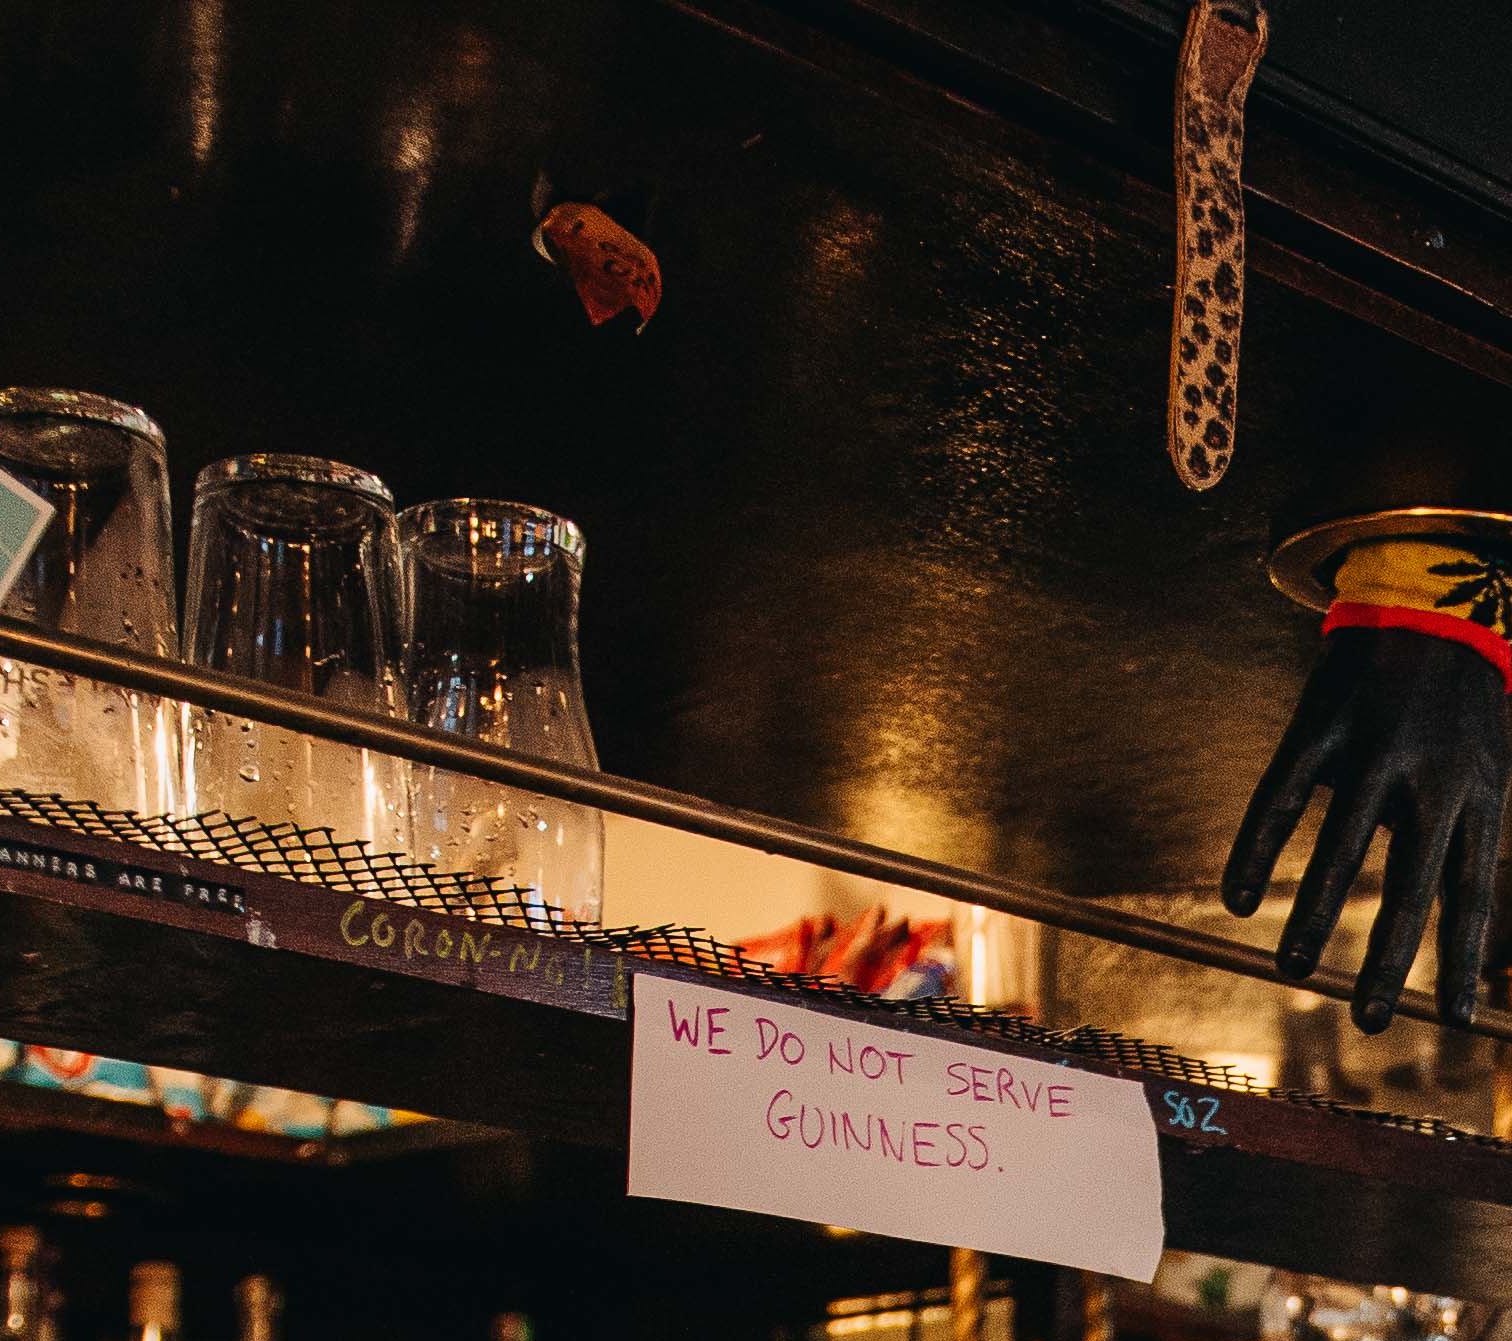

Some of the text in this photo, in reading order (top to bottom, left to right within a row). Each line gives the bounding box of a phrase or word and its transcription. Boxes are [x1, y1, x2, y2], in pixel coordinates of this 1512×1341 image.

[118, 873, 163, 893] ARE
[668, 1001, 1074, 1119] WE DO NOT SERVE
[767, 1089, 1006, 1173] GUINNESS.
